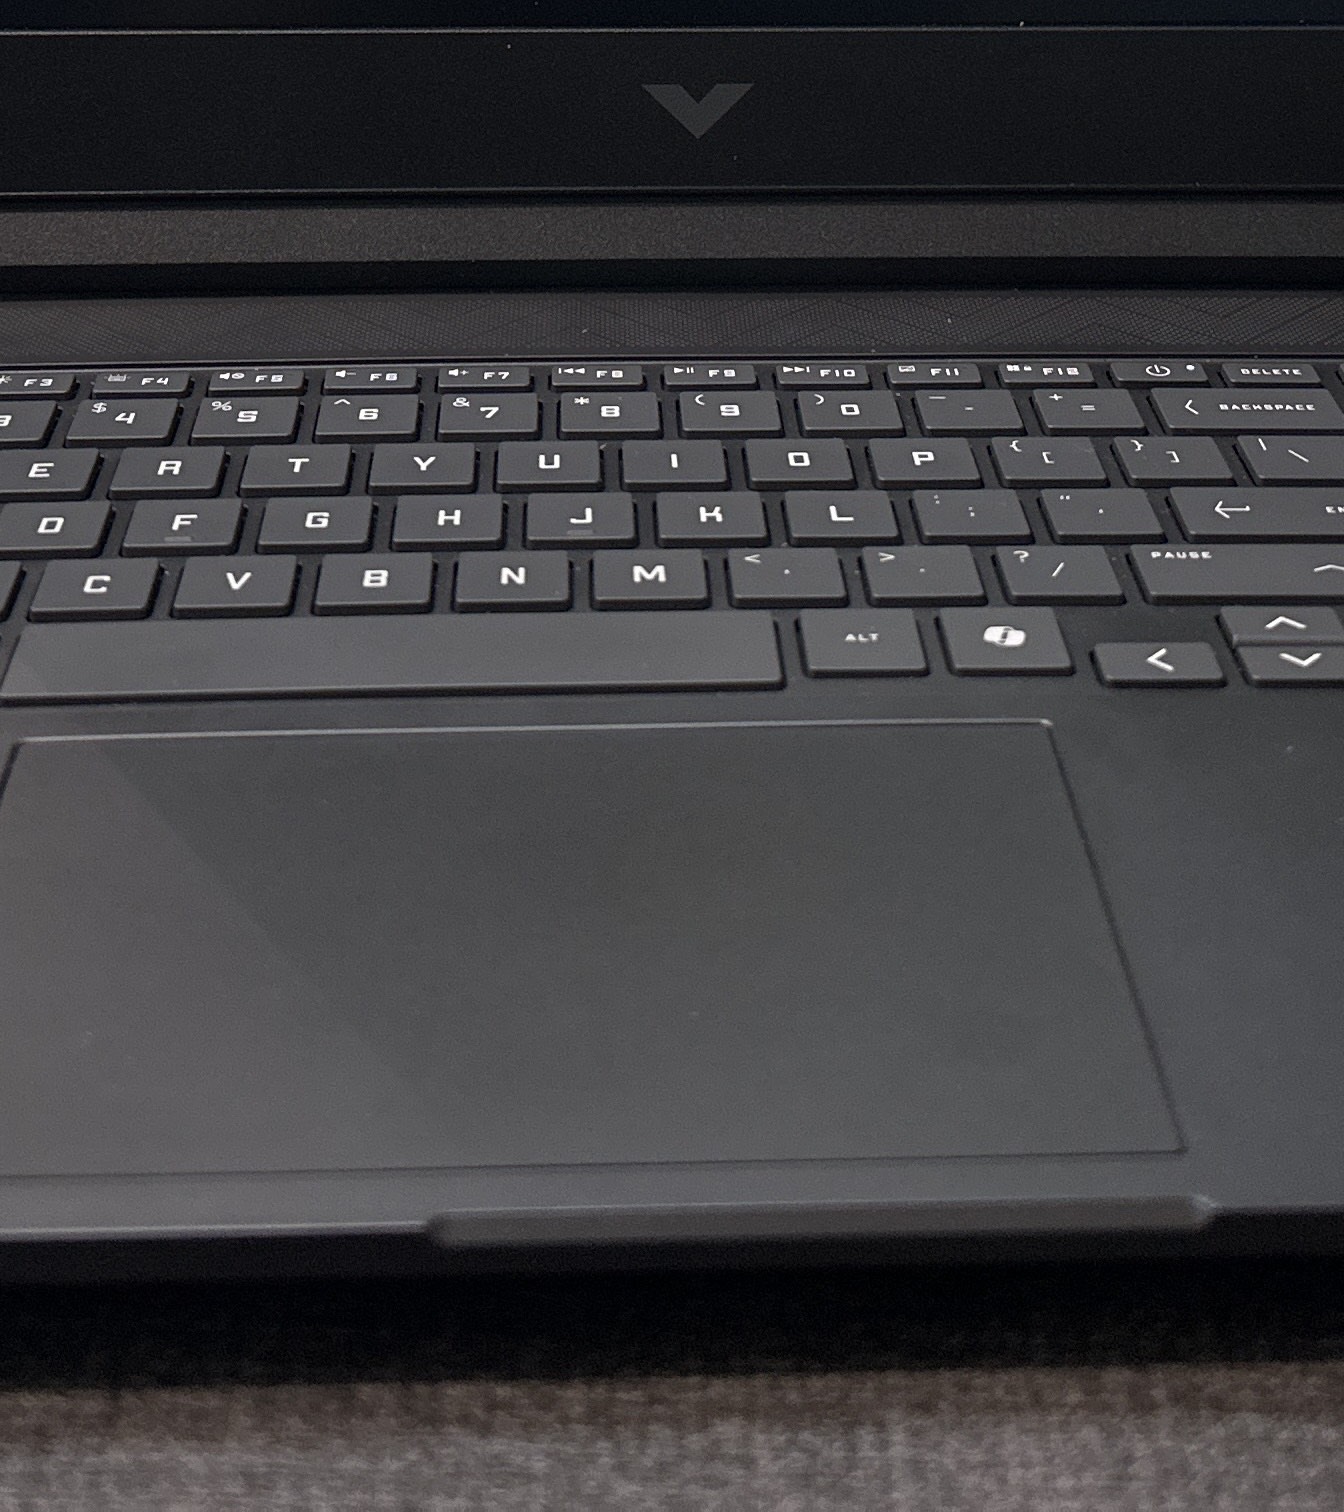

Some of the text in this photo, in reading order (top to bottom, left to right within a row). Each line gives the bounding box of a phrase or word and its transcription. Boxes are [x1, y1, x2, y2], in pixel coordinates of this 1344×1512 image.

[483, 371, 510, 380] F7
[819, 369, 856, 378] F10
[930, 367, 960, 377] F11
[23, 378, 54, 387] F3
[141, 377, 169, 386] F4
[358, 408, 379, 420] 6
[479, 406, 500, 419] 7
[600, 405, 620, 418] 8
[719, 404, 740, 417] 9
[1219, 403, 1316, 411] BACKSPACE
[114, 412, 136, 425] 4
[236, 410, 259, 423] 5
[288, 457, 310, 473] T
[413, 456, 436, 471] Y
[538, 454, 561, 470] U
[911, 451, 935, 466] P
[28, 462, 55, 478] E
[157, 460, 182, 476] R
[304, 511, 330, 529] G
[437, 509, 461, 526] H
[569, 507, 593, 524] J
[699, 506, 723, 523] K
[829, 505, 855, 522] L
[37, 517, 65, 534] D
[171, 514, 198, 531] F
[1150, 551, 1212, 559] PAUSE
[226, 571, 252, 590] V
[362, 569, 389, 588] B
[500, 566, 526, 585] N
[632, 565, 667, 583] M
[83, 575, 111, 593] C
[845, 632, 879, 642] ALT
